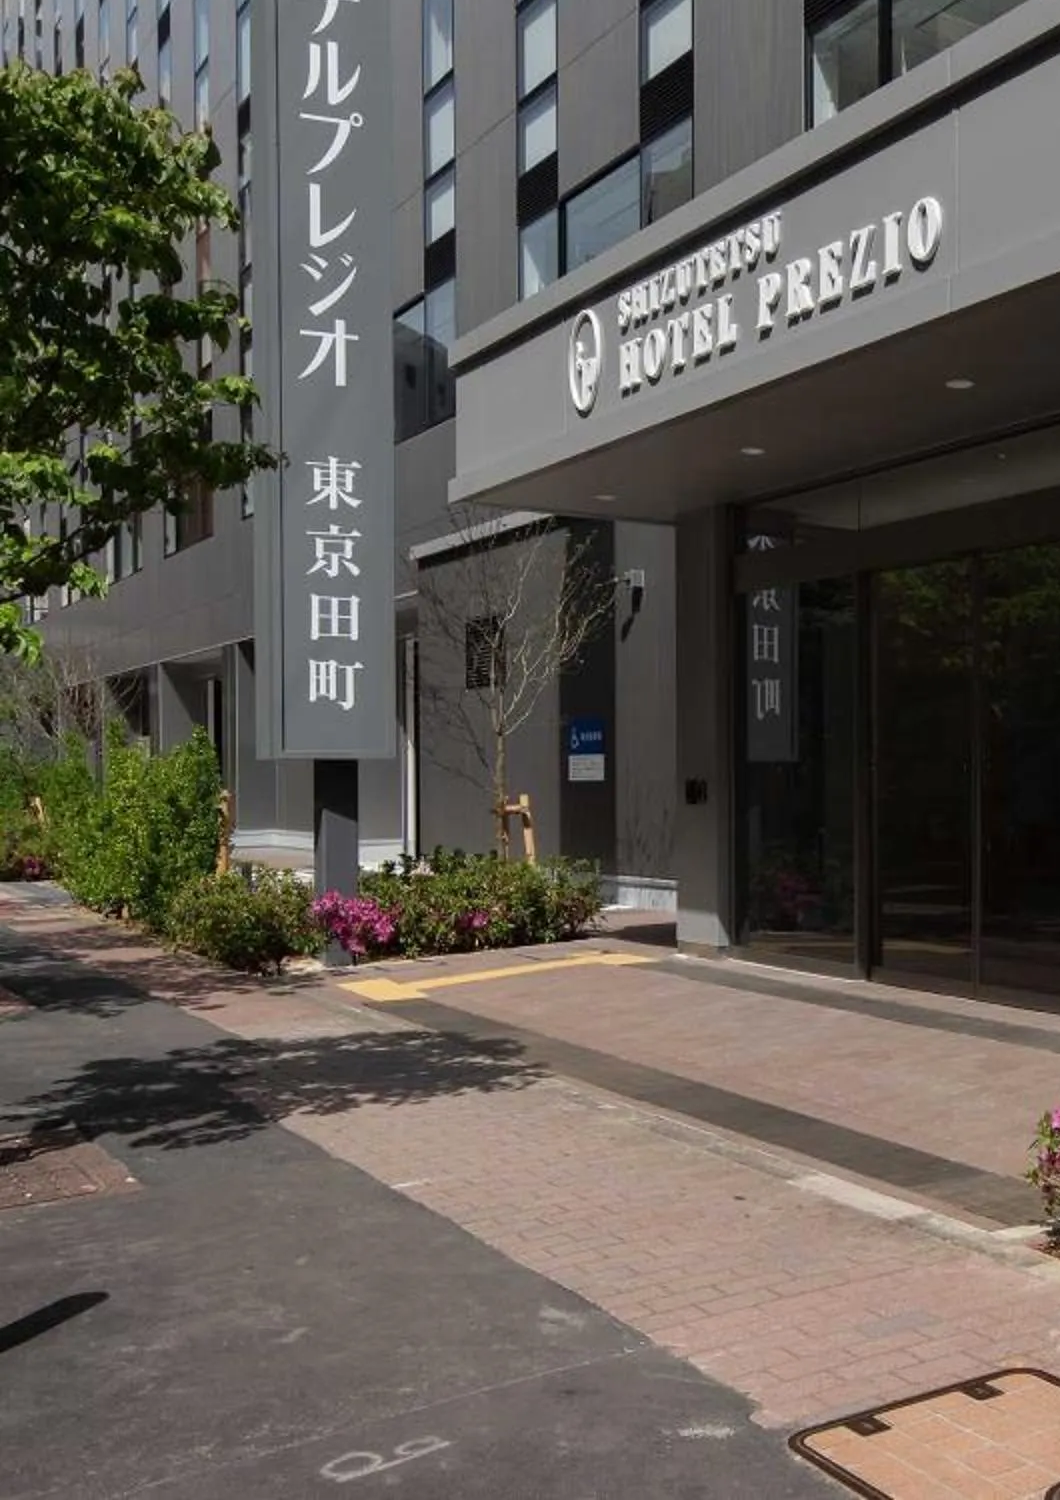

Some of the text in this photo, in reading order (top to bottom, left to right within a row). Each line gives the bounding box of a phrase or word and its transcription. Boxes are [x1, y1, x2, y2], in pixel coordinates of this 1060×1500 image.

[617, 211, 782, 327] SHIZUTETSU
[618, 196, 943, 390] HOTEL PREZIO
[305, 455, 365, 711] 東京田町
